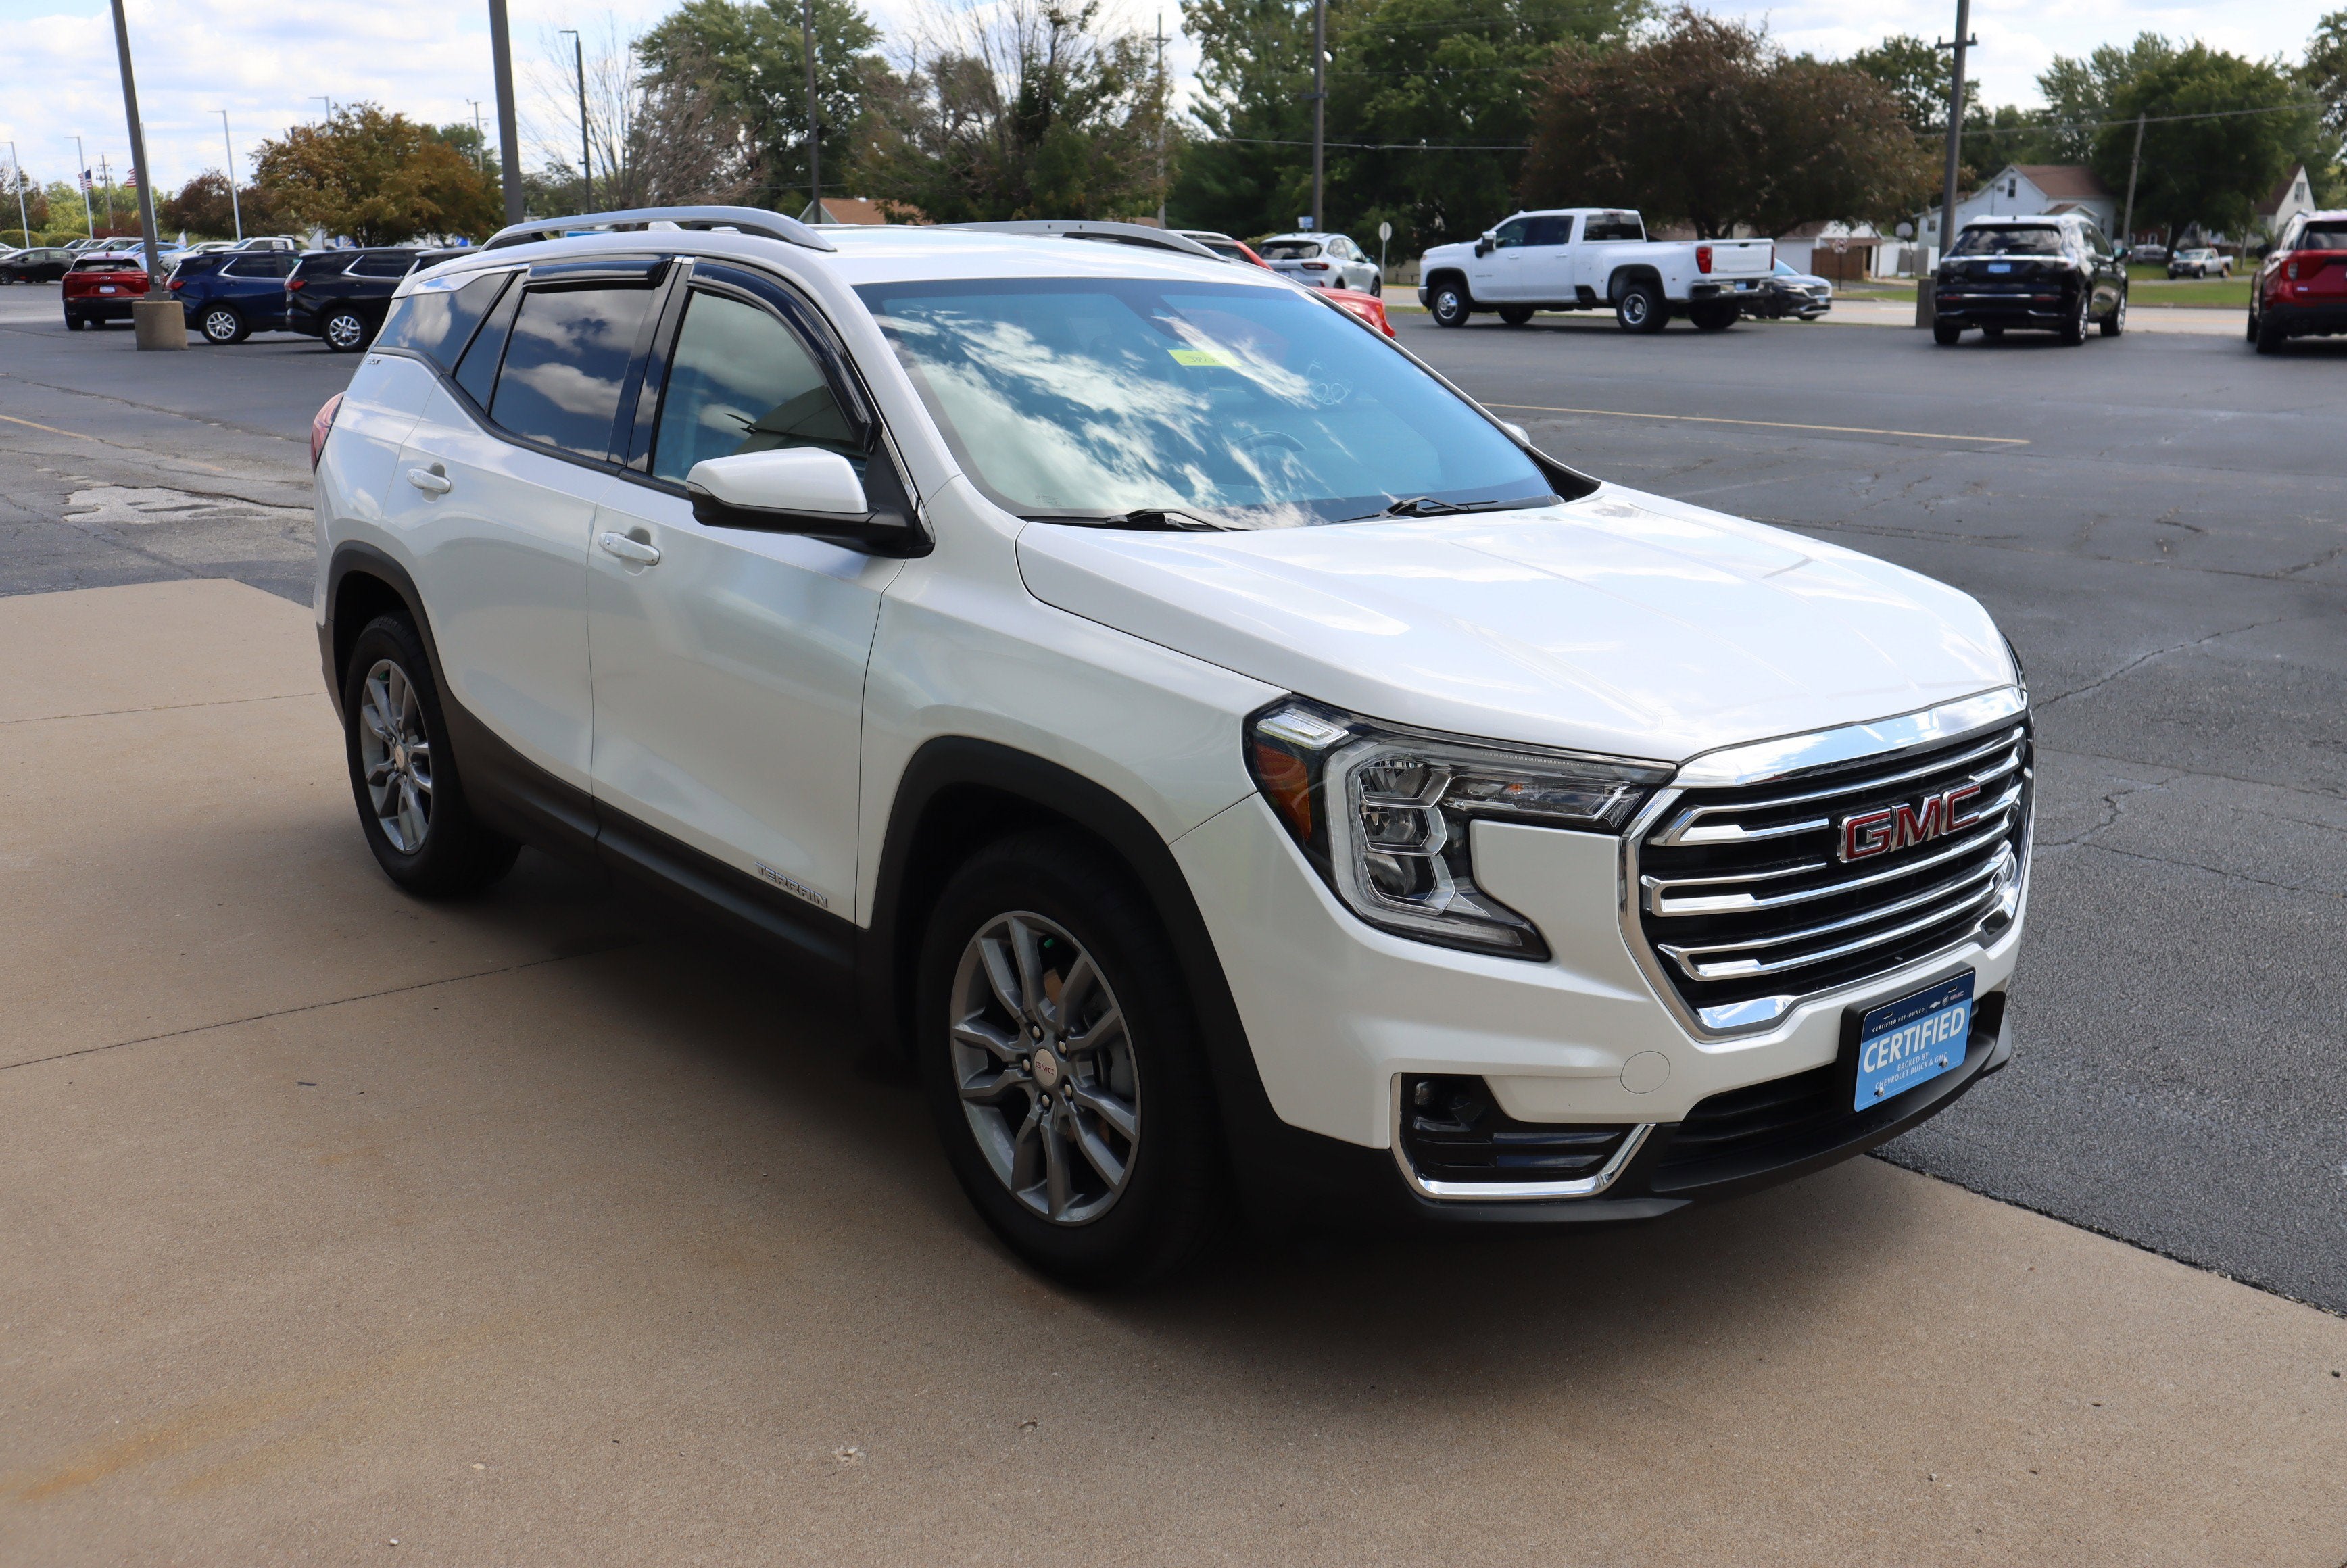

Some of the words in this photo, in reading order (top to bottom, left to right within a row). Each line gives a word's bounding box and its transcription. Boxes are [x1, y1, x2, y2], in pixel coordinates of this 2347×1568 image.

[1839, 781, 1981, 864] GMC
[754, 861, 828, 908] TERRAIN
[1863, 1007, 1966, 1073] CERTIFIED
[1872, 1019, 1897, 1033] CERTIFIED
[1036, 1061, 1055, 1075] GMC
[1875, 1071, 1909, 1090] CHEVROLET
[1910, 1061, 1928, 1075] BUICK
[1935, 1052, 1947, 1064] GMC
[1897, 1056, 1920, 1072] BACKED
[1921, 1052, 1929, 1061] BY
